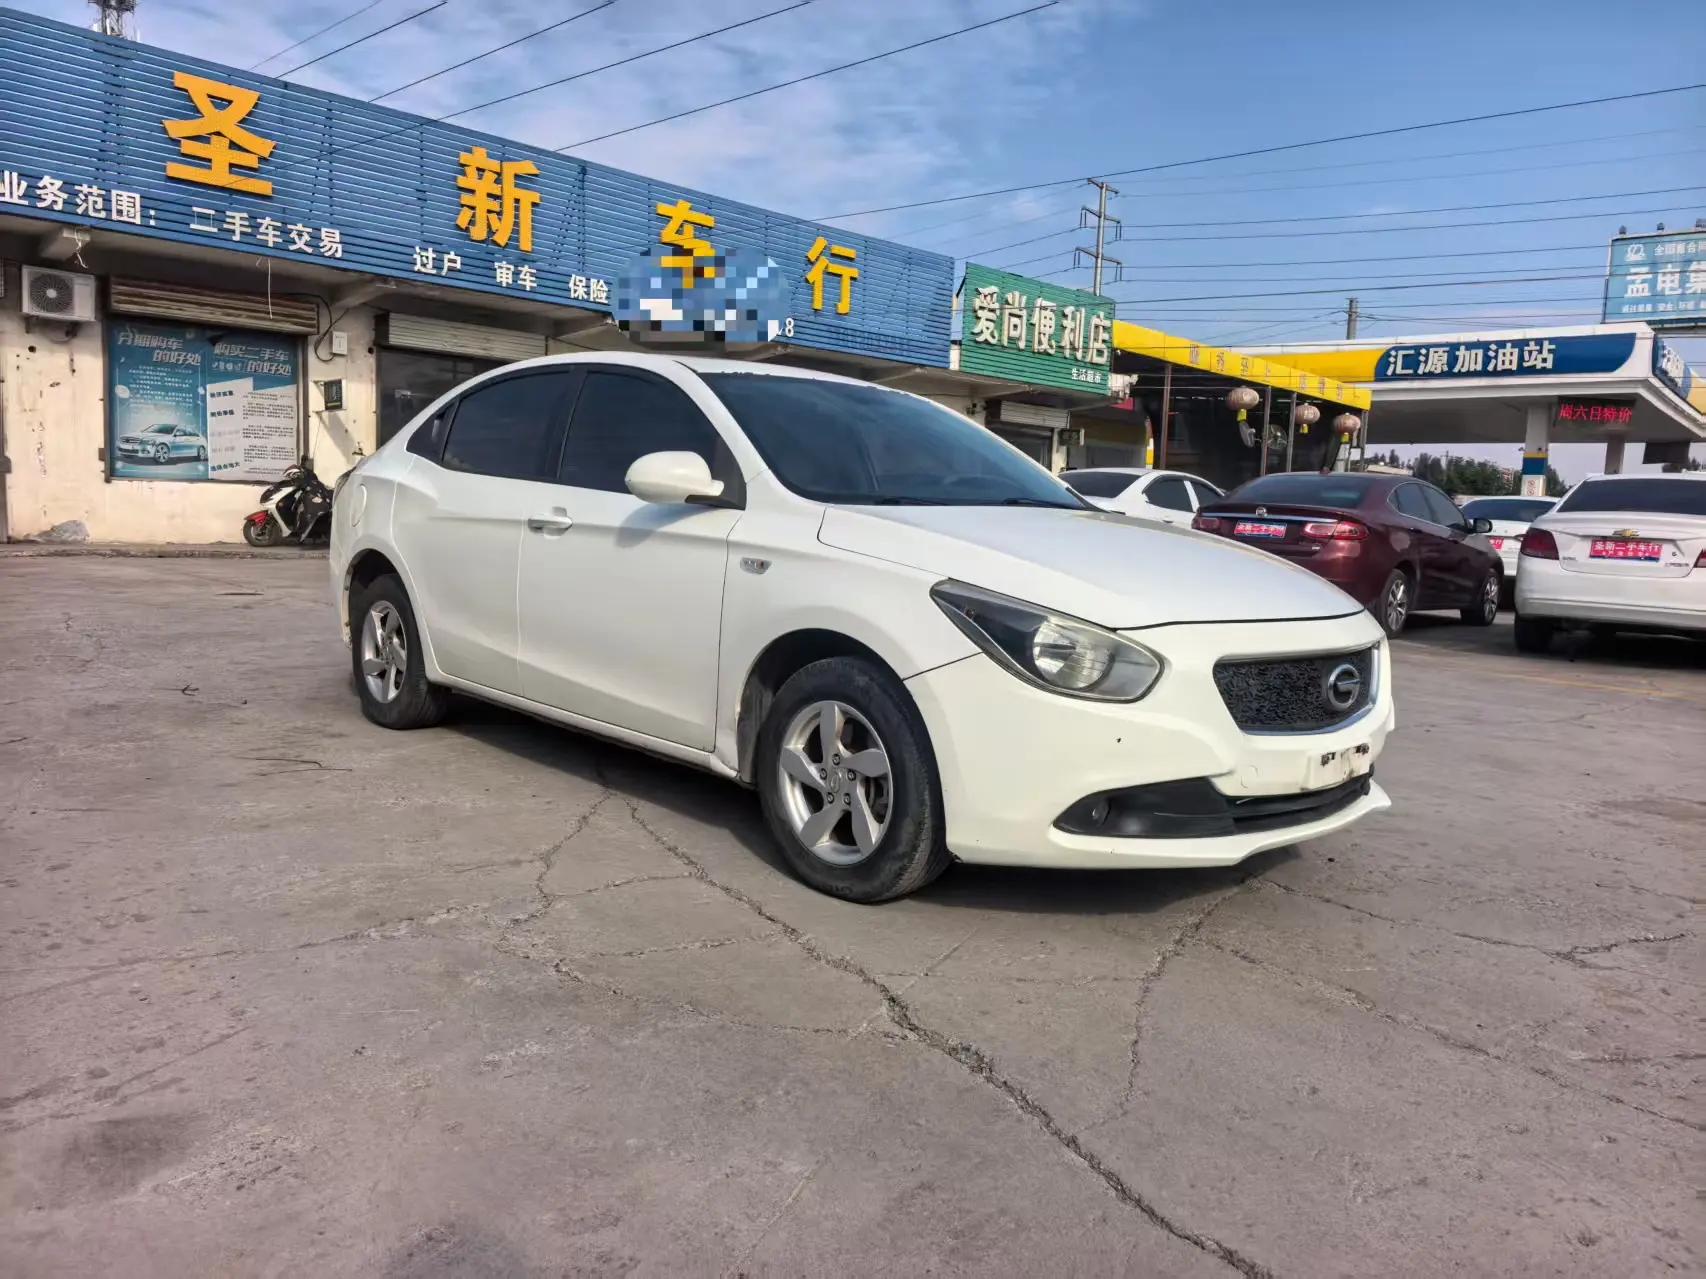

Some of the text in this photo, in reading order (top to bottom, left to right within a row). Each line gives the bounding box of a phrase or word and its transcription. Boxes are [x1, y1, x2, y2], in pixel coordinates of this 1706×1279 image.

[189, 206, 343, 259] 二手车交易
[413, 247, 462, 276] 过户
[493, 260, 538, 291] 审车
[567, 274, 609, 304] 保险
[972, 285, 1112, 365] 爱尚便利店
[152, 349, 202, 366] 的好处
[213, 343, 289, 361] 购买二手车
[1386, 340, 1556, 376] 汇源加油站
[247, 360, 292, 376] 的好处
[1071, 367, 1102, 384] 生活超市
[1559, 403, 1632, 424] 周六日特价
[1594, 541, 1660, 552] 圣新二手车行
